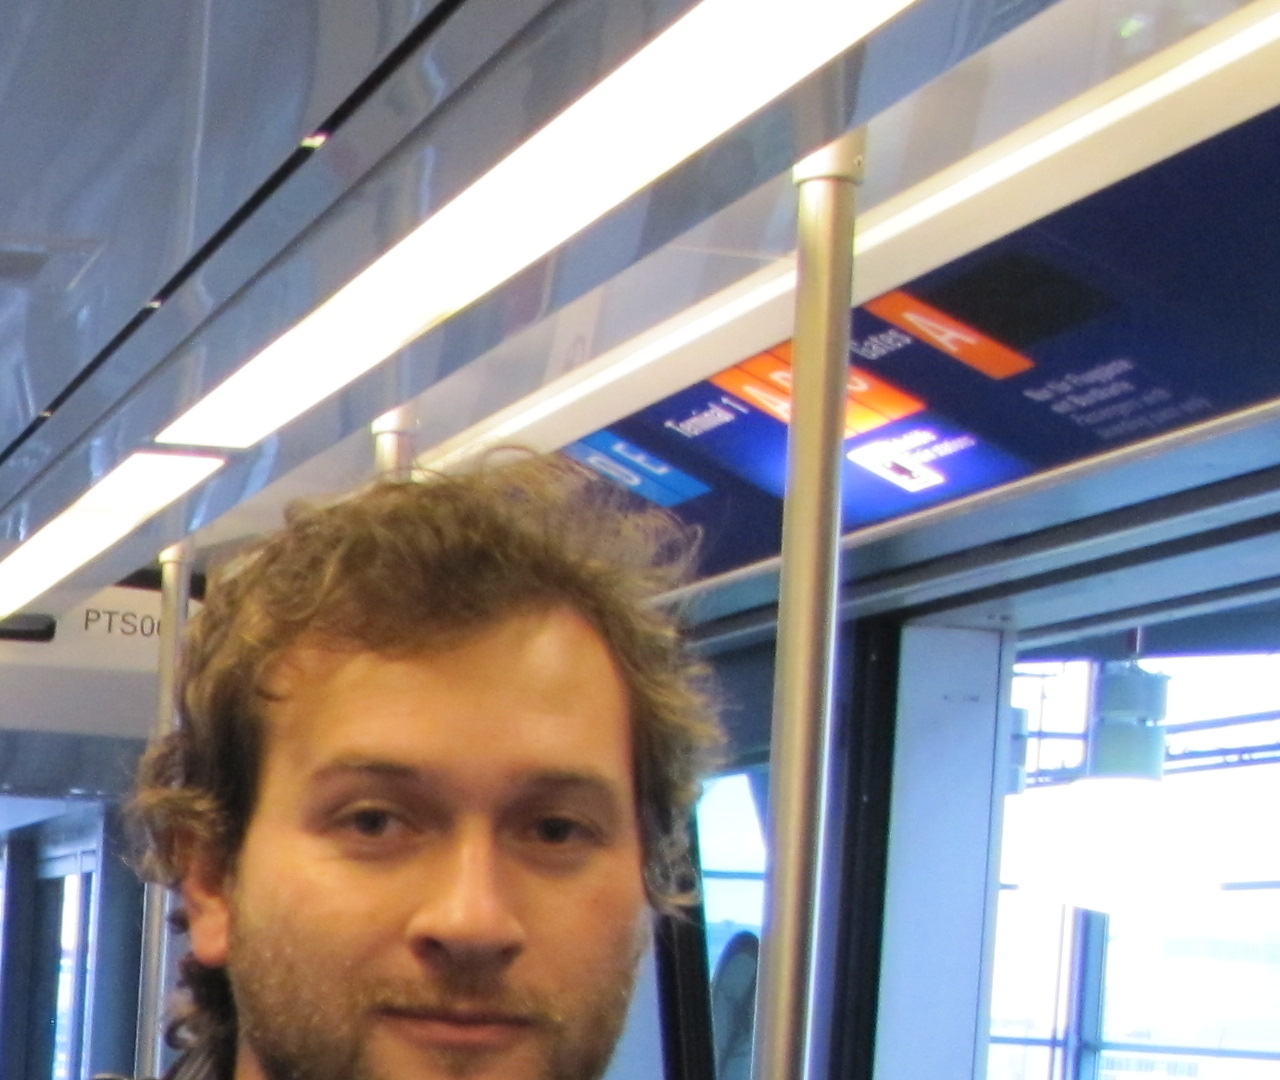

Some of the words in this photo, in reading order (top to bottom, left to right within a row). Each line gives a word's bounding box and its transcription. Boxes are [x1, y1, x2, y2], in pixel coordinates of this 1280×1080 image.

[902, 311, 978, 353] A
[664, 402, 734, 438] Terminal
[721, 396, 750, 414] 1
[611, 441, 670, 475] E
[84, 608, 161, 637] PTS0
